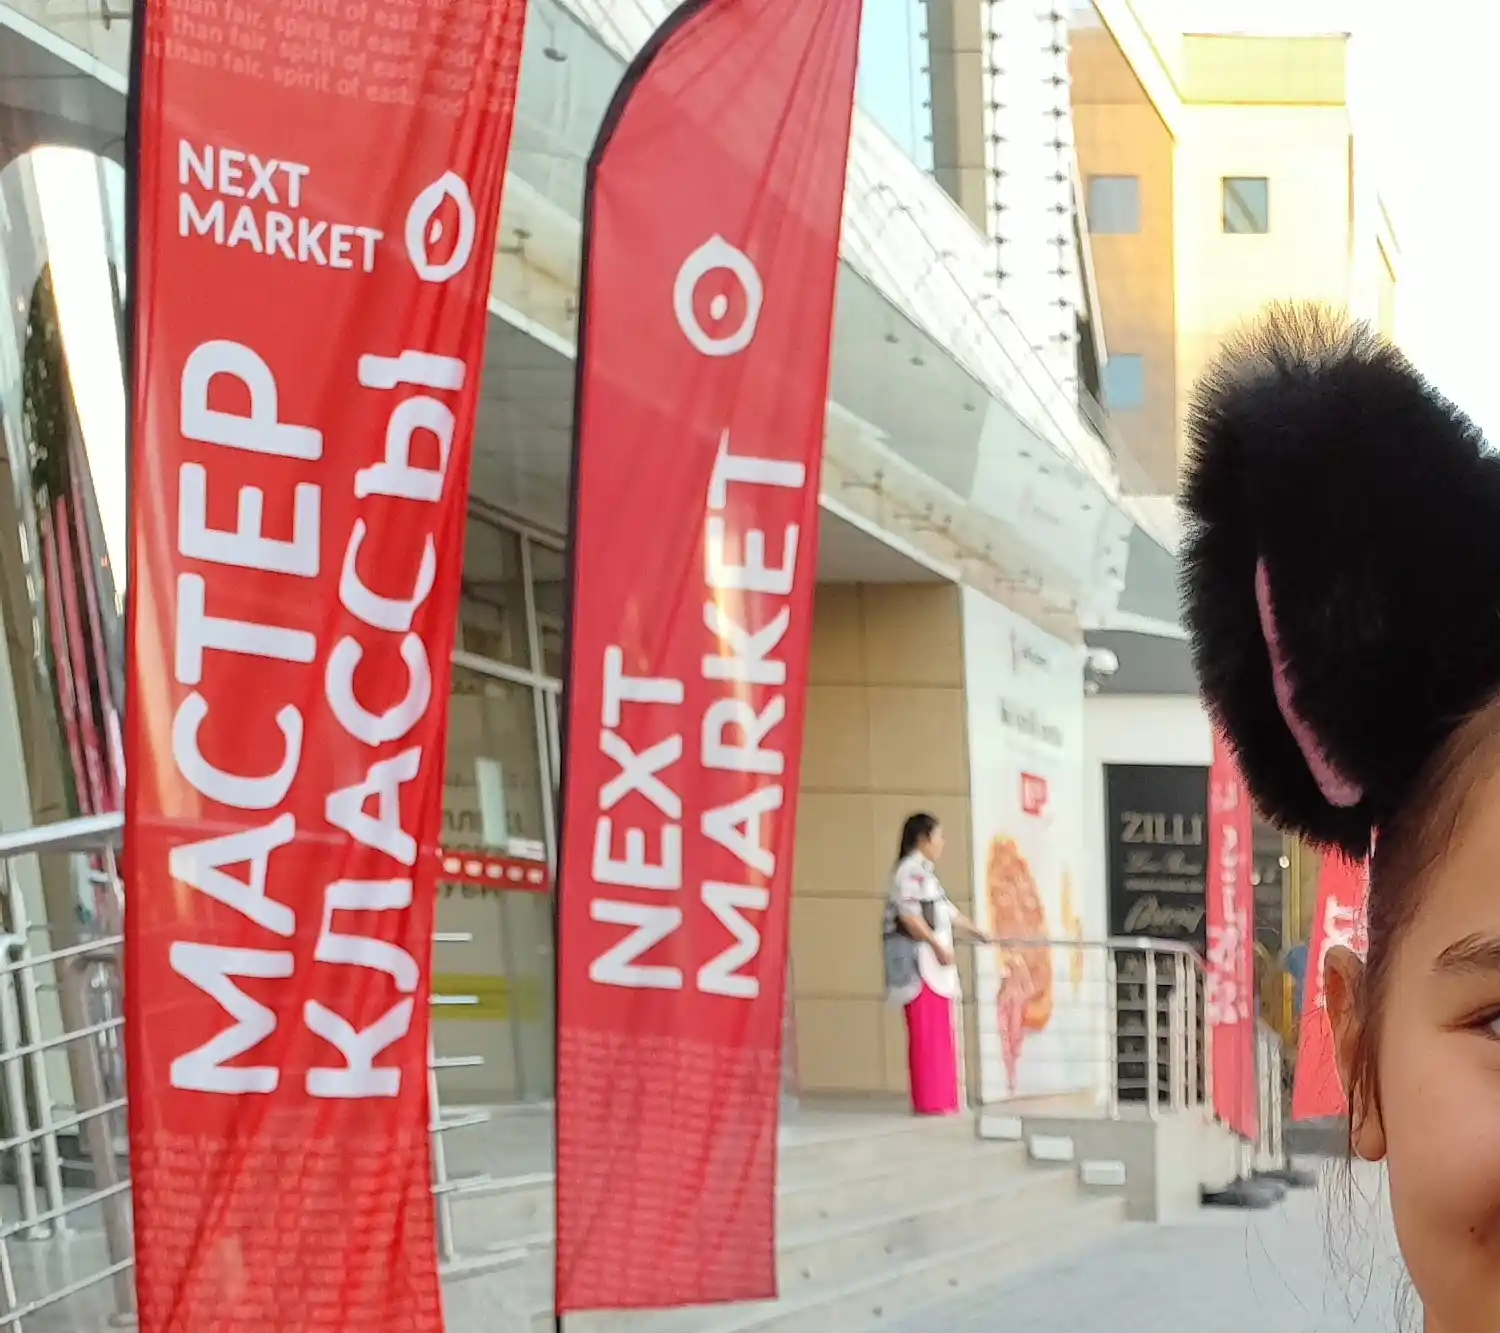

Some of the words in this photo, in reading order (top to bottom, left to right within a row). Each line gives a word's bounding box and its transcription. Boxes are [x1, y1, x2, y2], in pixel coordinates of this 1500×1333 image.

[178, 139, 309, 208] NEXT
[178, 192, 384, 273] MARKET
[169, 339, 323, 1094] МАСТЕР
[303, 350, 466, 1098] КЛАССЫ
[588, 645, 685, 990] NEXT
[696, 428, 806, 999] MARKET
